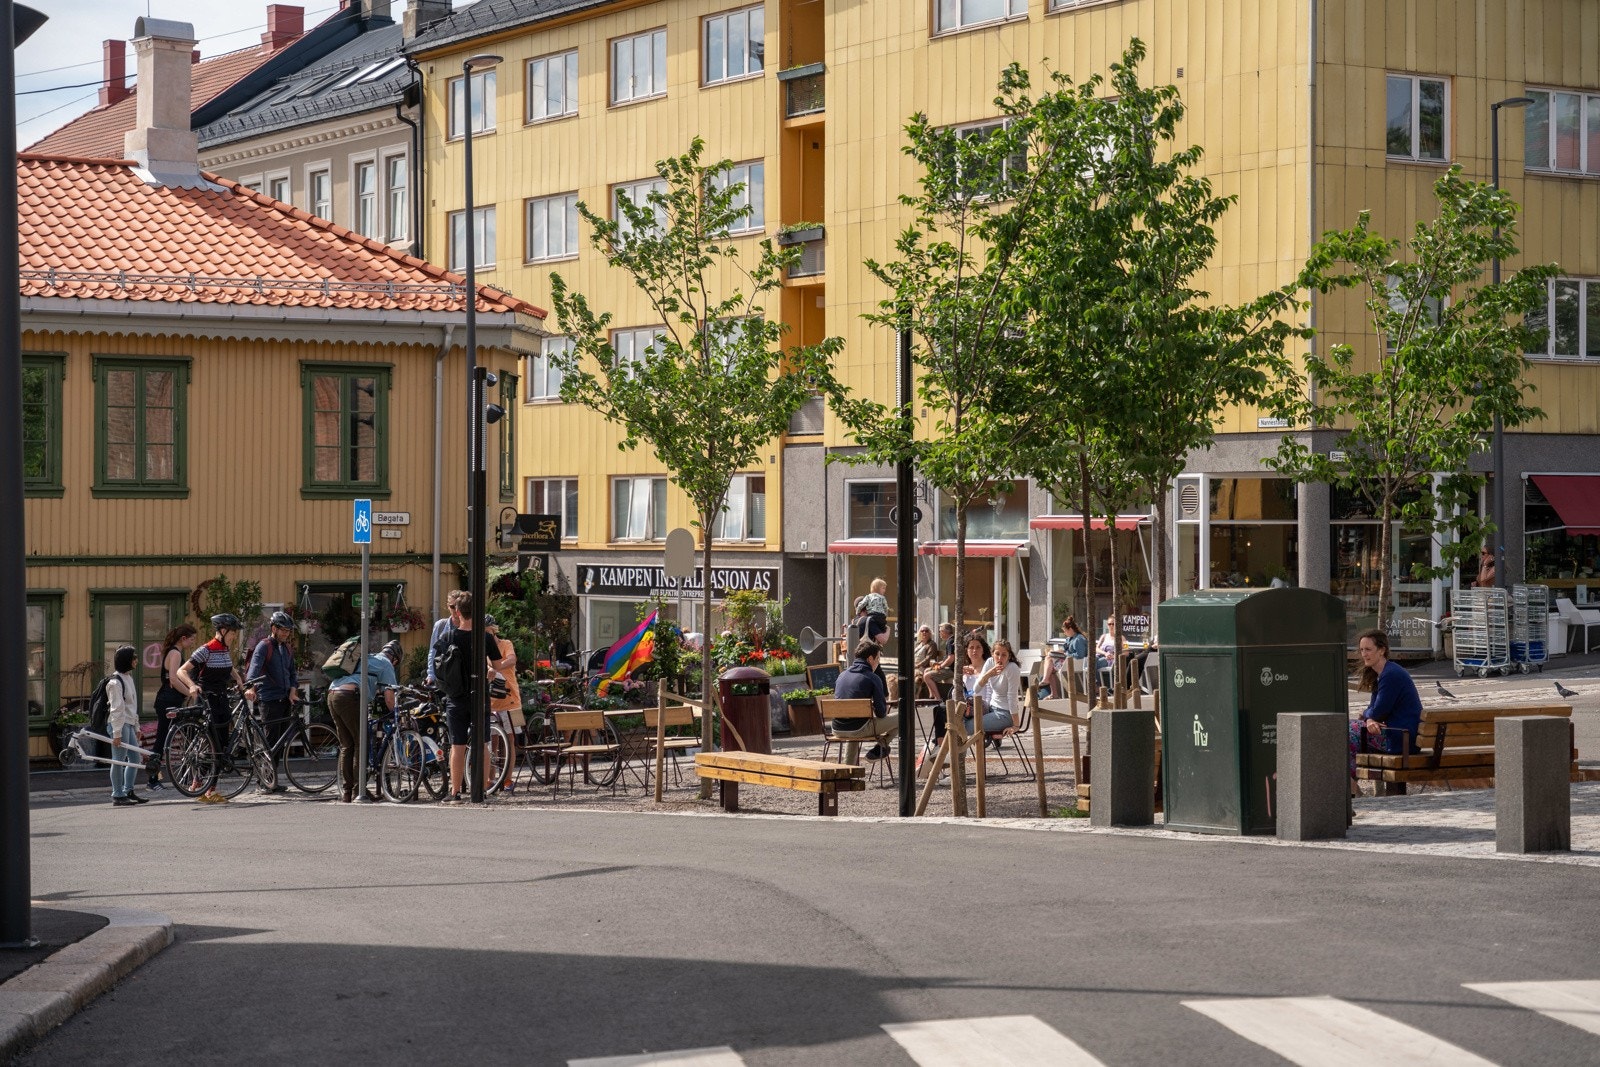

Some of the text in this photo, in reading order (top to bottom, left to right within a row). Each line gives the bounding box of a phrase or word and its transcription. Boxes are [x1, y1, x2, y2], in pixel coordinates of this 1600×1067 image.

[378, 514, 403, 523] Bøgata
[599, 567, 653, 587] KAMPEN
[753, 570, 771, 591] AS
[1123, 614, 1150, 625] KAMPEN
[1412, 629, 1426, 637] BAR
[1185, 676, 1197, 684] Oslo
